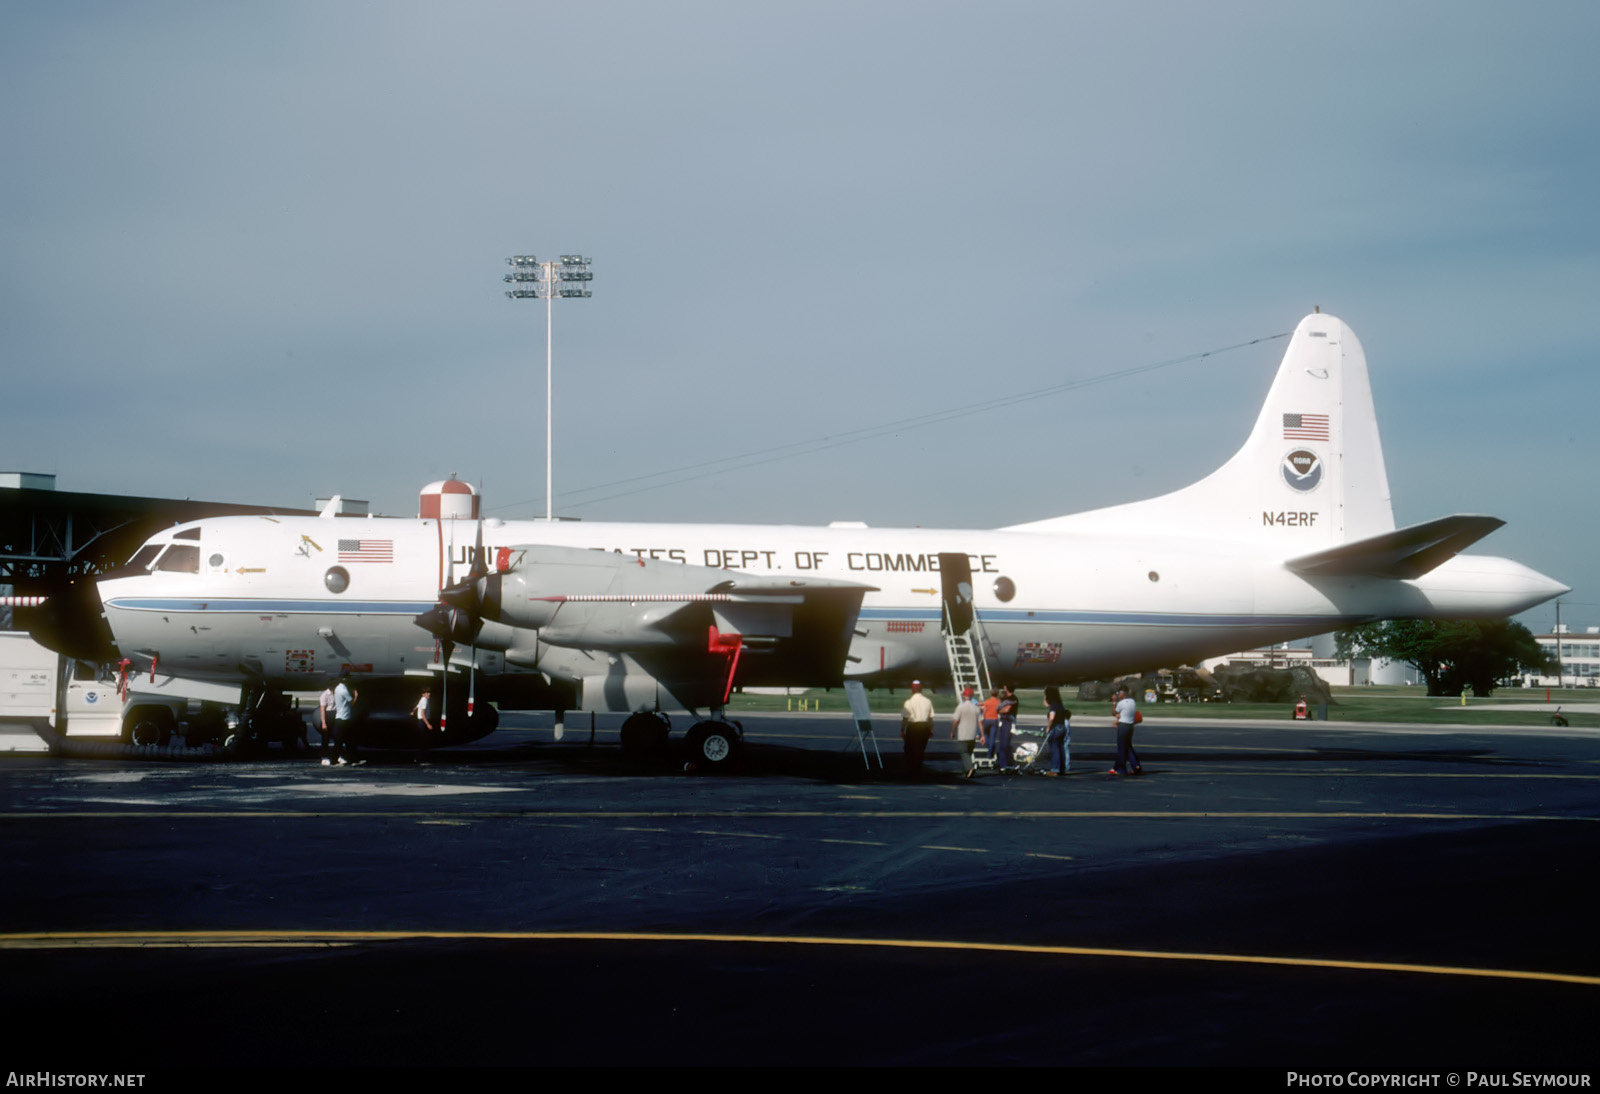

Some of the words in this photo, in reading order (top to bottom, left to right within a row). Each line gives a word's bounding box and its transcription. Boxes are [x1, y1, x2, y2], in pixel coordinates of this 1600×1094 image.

[1262, 511, 1319, 527] N42RF
[703, 549, 782, 569] DEPT.
[795, 551, 829, 570] OF
[847, 552, 1000, 574] COMMECE
